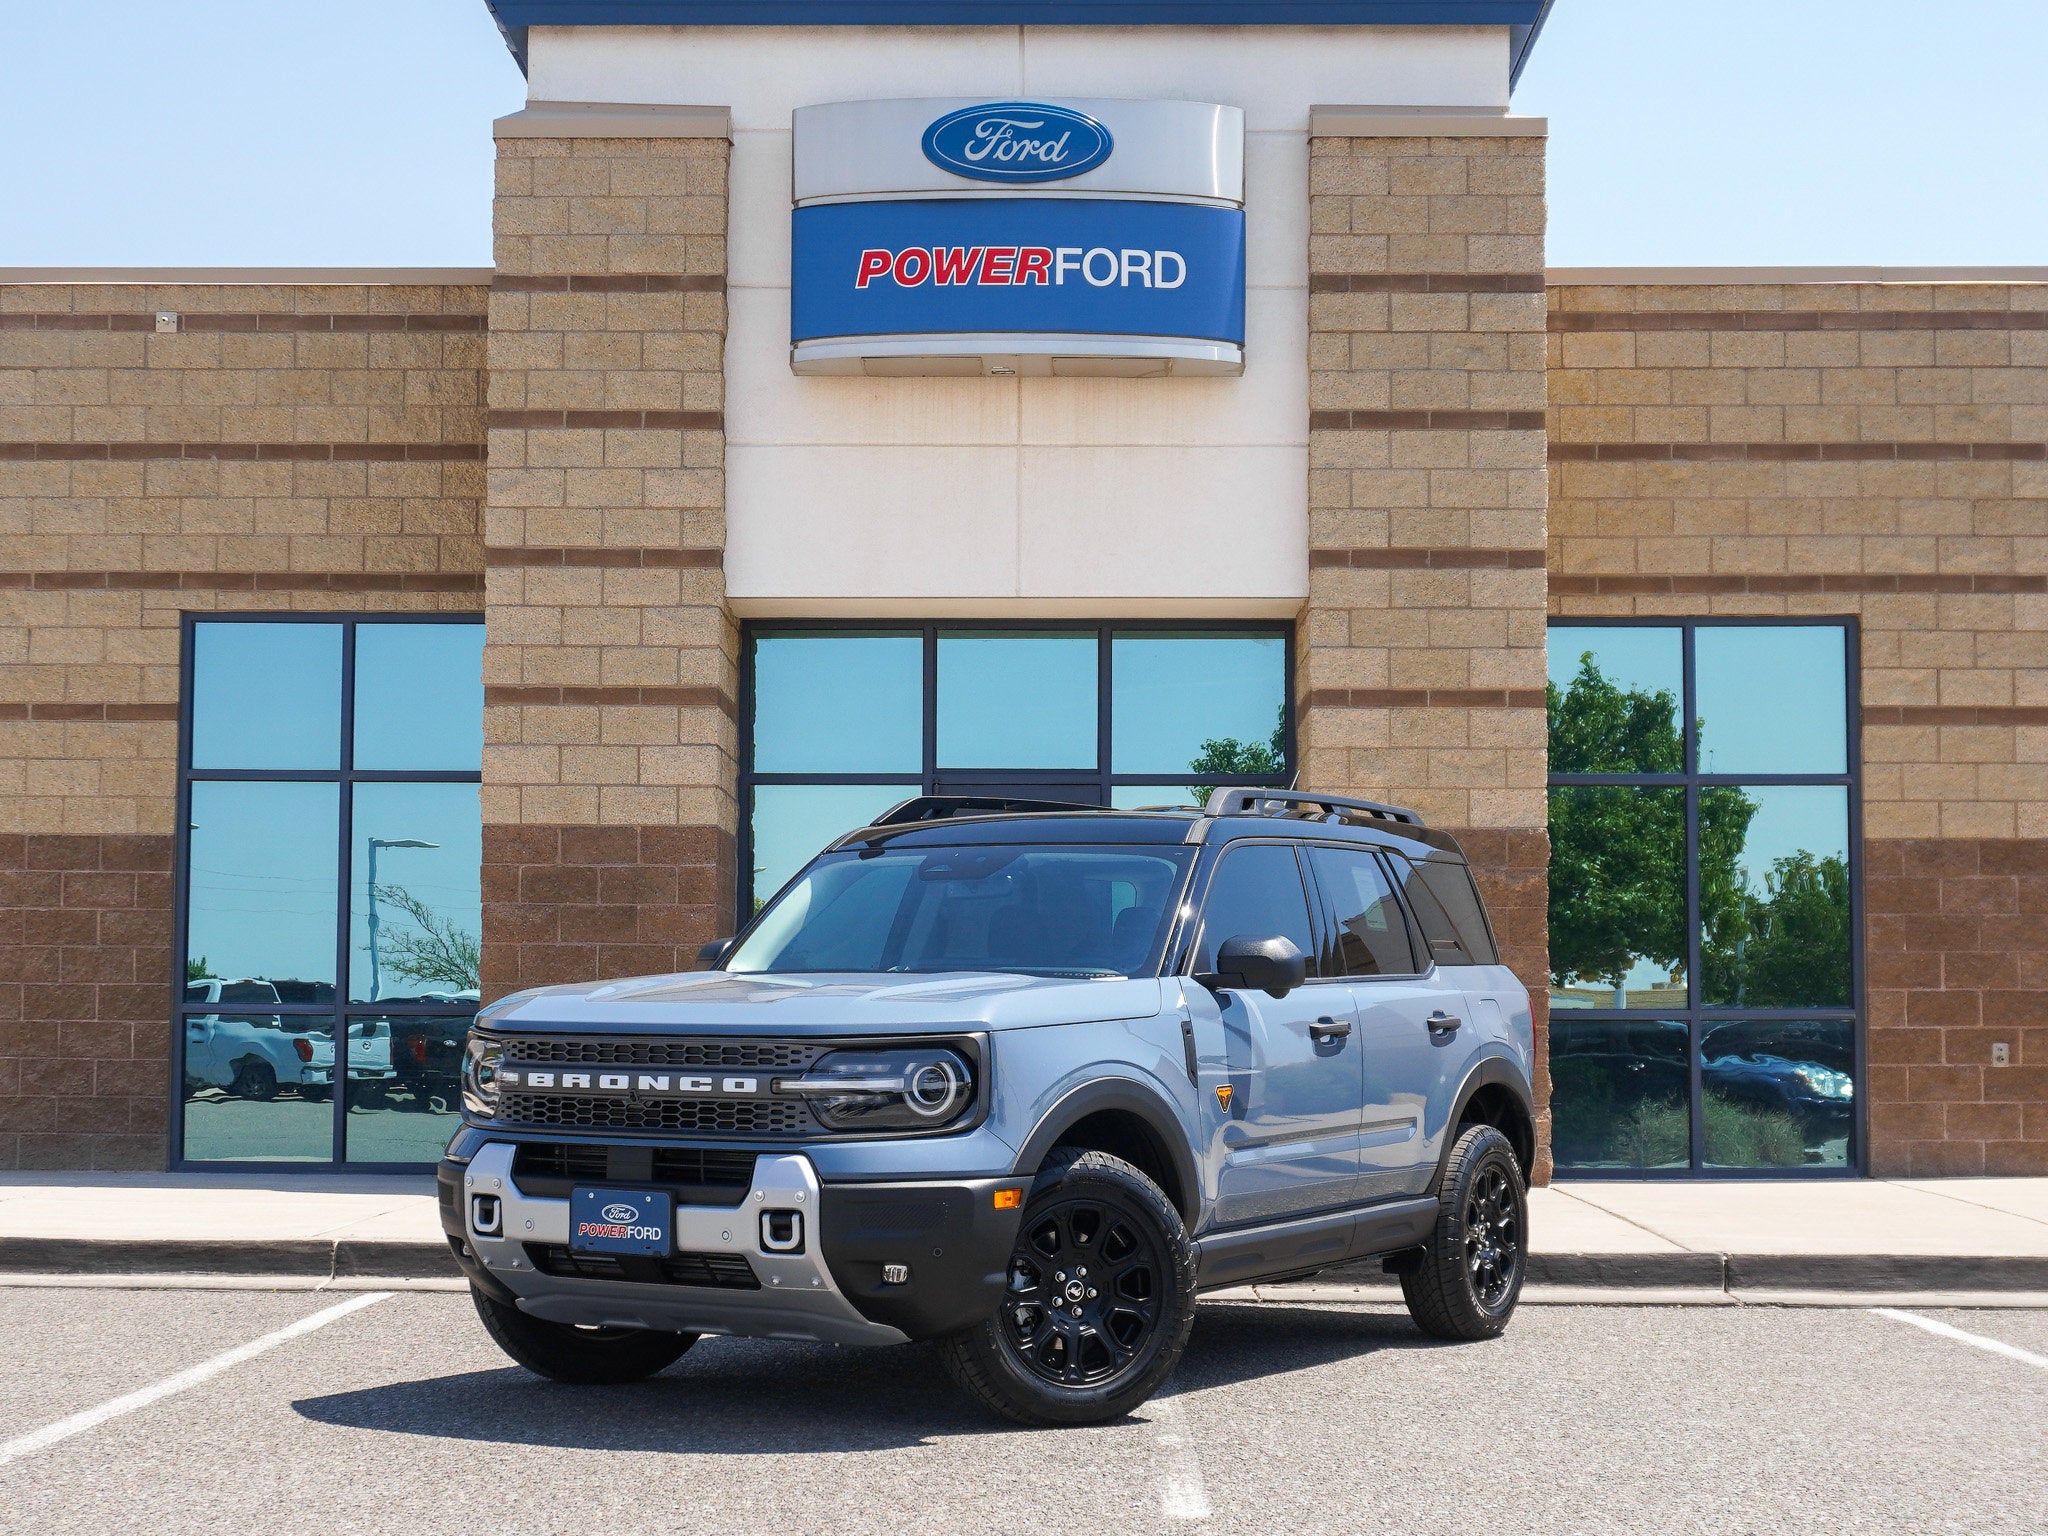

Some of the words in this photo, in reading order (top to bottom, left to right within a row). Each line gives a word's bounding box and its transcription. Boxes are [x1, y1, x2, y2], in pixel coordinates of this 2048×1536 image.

[964, 118, 1071, 162] Ford
[854, 246, 1187, 289] POWERFORD
[527, 1072, 758, 1093] BRONCO
[608, 1207, 631, 1220] Ford
